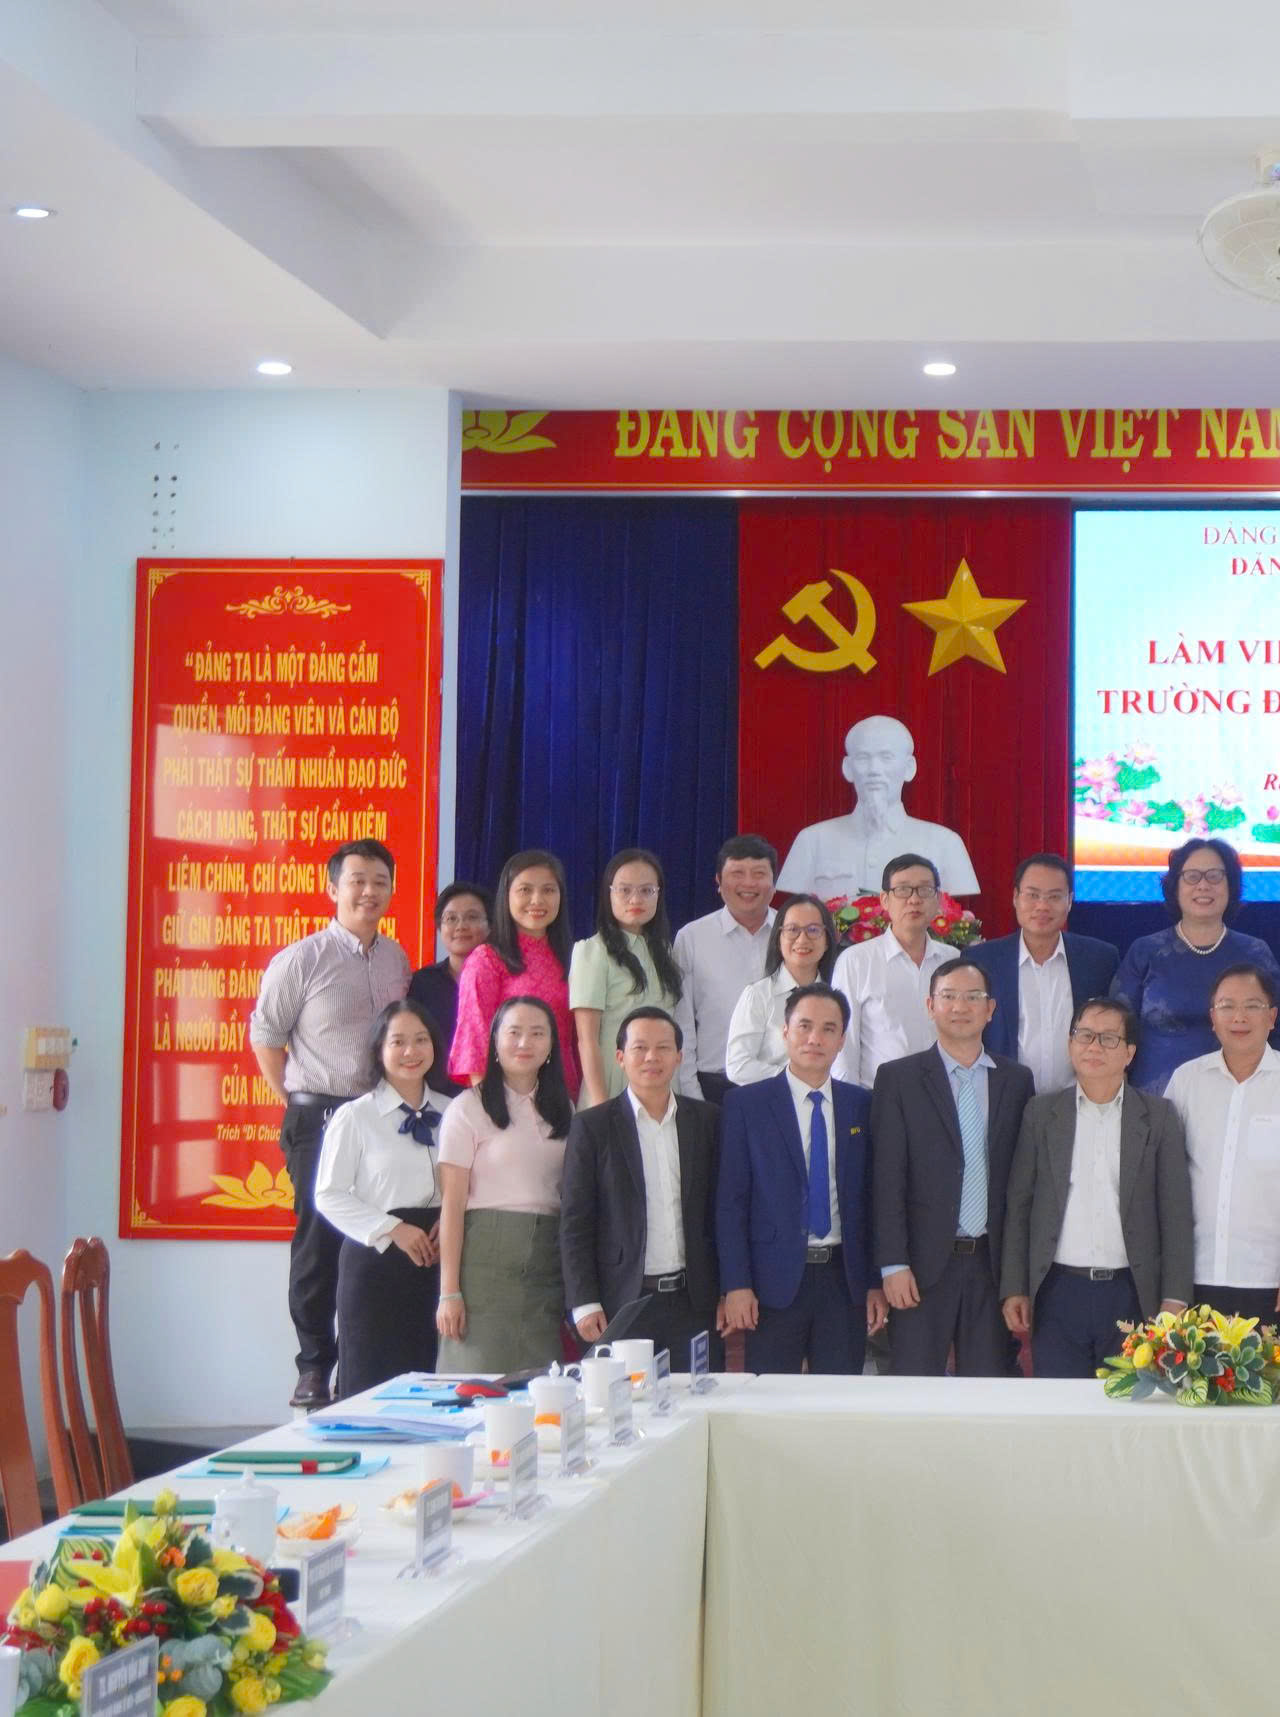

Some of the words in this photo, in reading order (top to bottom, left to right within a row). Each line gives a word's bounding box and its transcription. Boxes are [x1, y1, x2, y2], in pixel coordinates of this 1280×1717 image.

[234, 652, 250, 682] TA
[255, 645, 272, 682] LÀ
[276, 646, 306, 688] MỘT
[309, 641, 345, 683] ĐẢNG
[348, 640, 378, 683] CẦM
[1148, 632, 1226, 664] LÀM
[226, 690, 251, 735] MỖI
[254, 692, 290, 736] ĐẢNG
[294, 696, 325, 736] VIÊN
[328, 696, 346, 736] VÀ
[350, 696, 376, 736] CÁN
[380, 696, 400, 742] BỘ
[1096, 682, 1250, 714] TRƯỜNG
[198, 751, 232, 792] THẬT
[236, 752, 255, 792] SỰ
[258, 746, 296, 788] THẤM
[300, 745, 345, 788] NHUẦN
[348, 758, 376, 795] ĐẠO
[380, 750, 408, 789] ĐỨC
[177, 802, 212, 839] CÁCH
[262, 802, 297, 847] THẬT
[300, 805, 320, 847] SỰ
[322, 798, 349, 841] CẦN
[168, 853, 200, 893] LIÊM
[205, 855, 249, 896] CHÍNH,
[253, 854, 276, 894] CHÍ
[279, 855, 315, 894] CÔNG
[215, 904, 250, 945] ĐẢNG
[254, 916, 271, 946] TA
[154, 956, 186, 999] PHẢI
[154, 1012, 171, 1051] LÀ
[220, 1008, 246, 1052] ĐẦY
[222, 1064, 248, 1105] CỦA
[216, 1124, 241, 1142] Trích
